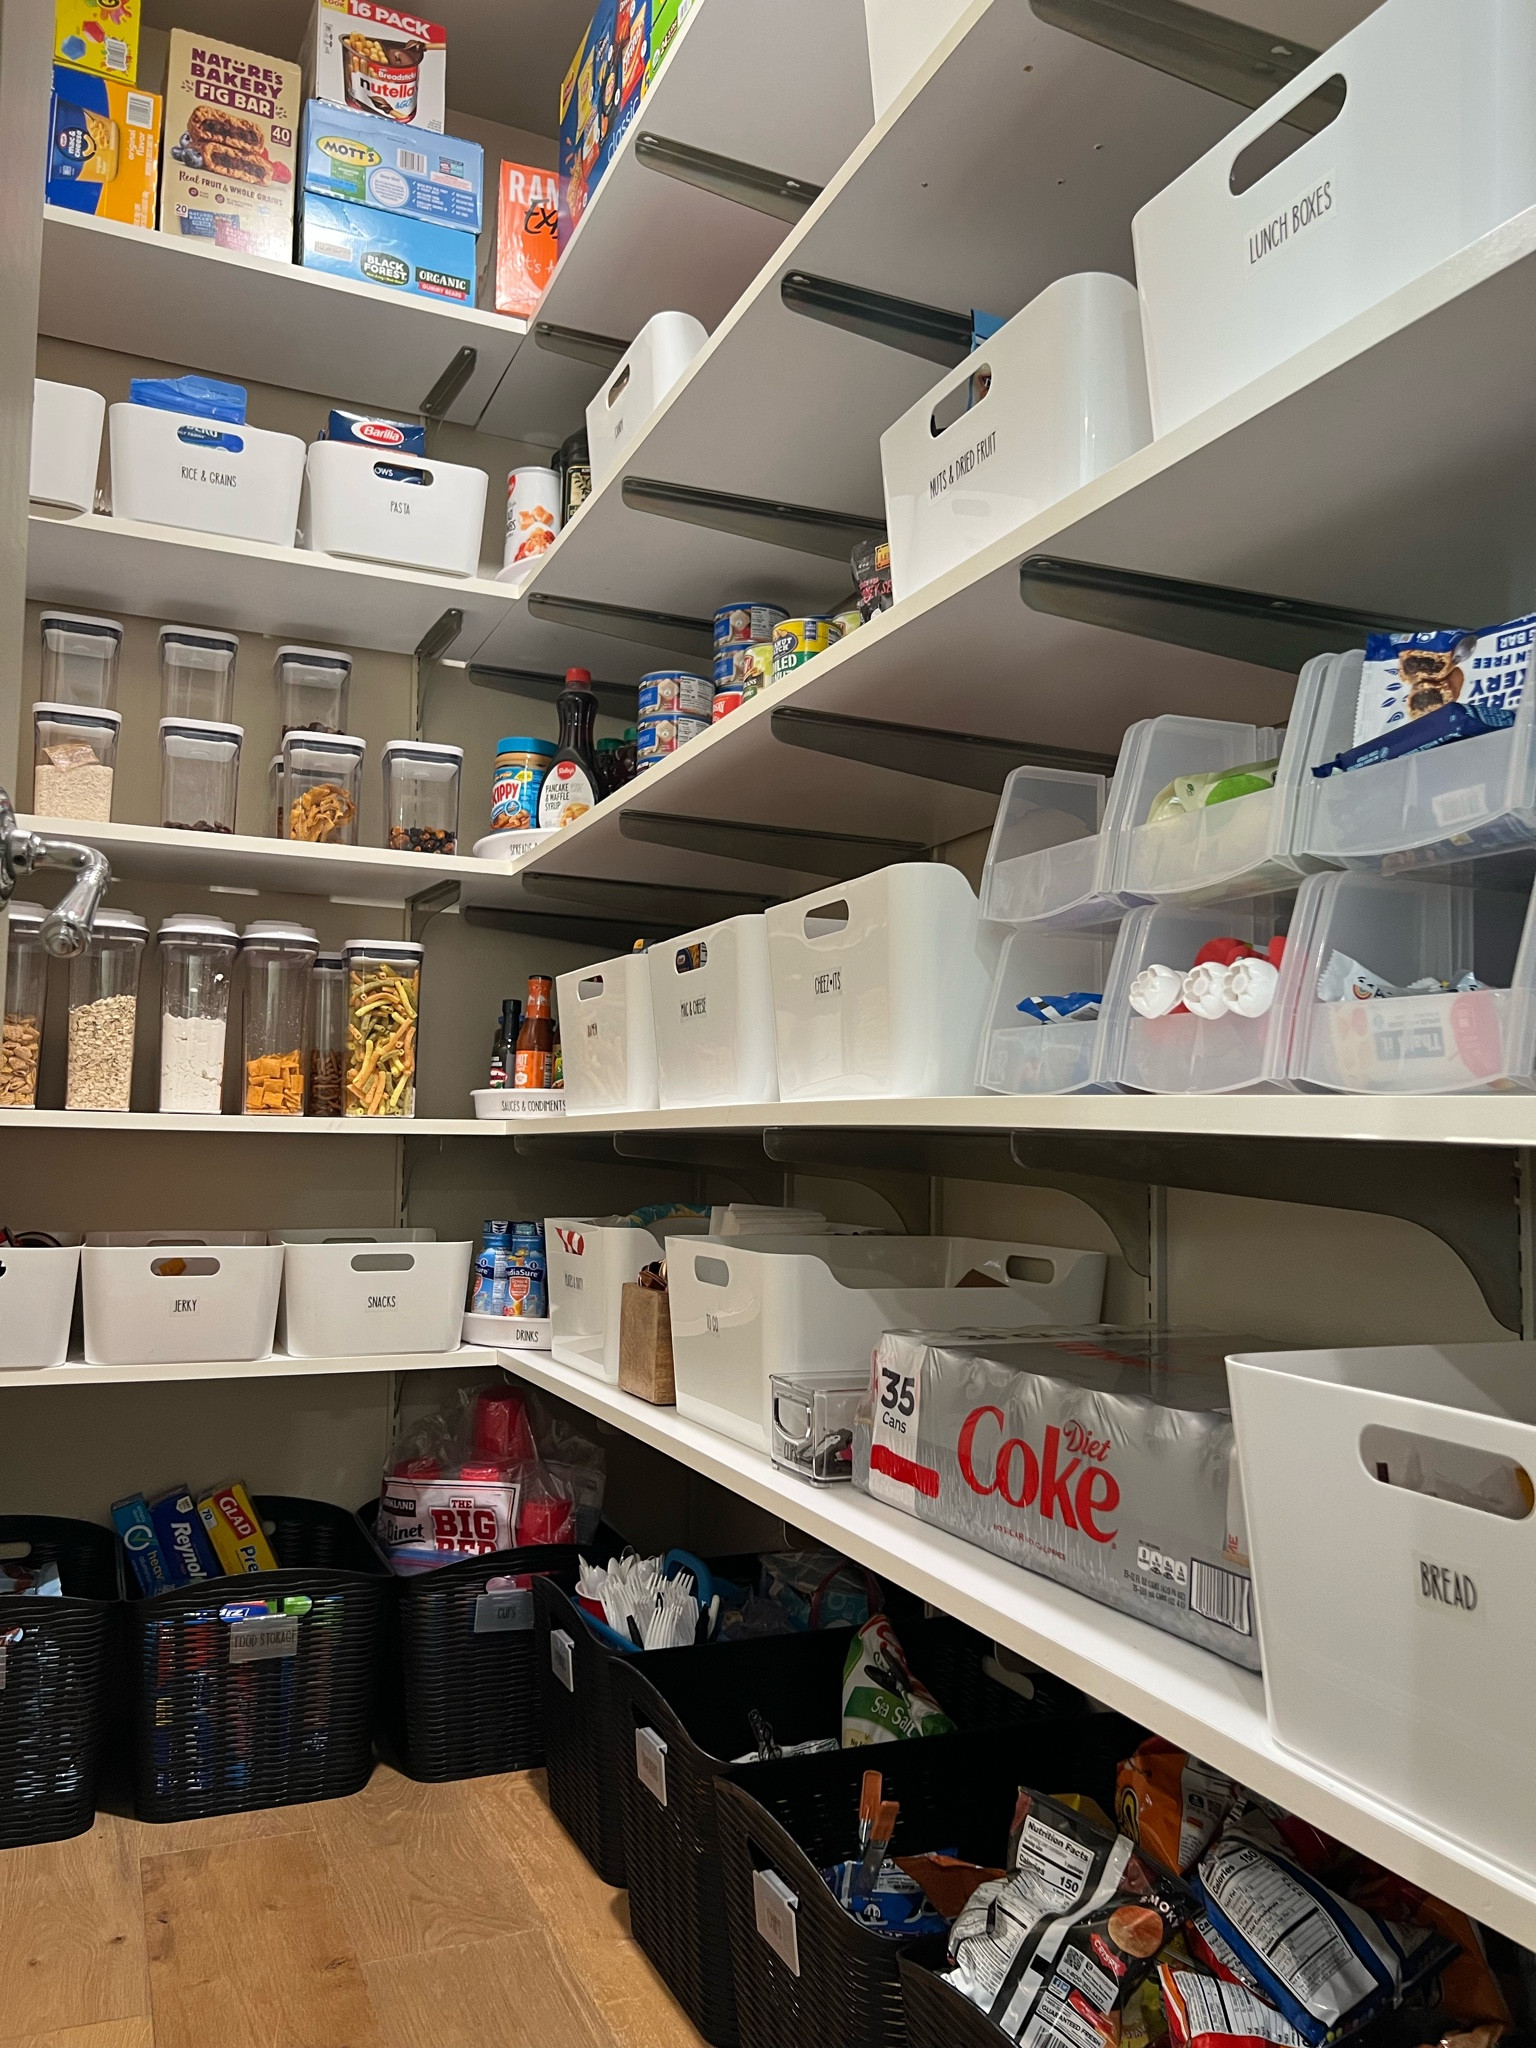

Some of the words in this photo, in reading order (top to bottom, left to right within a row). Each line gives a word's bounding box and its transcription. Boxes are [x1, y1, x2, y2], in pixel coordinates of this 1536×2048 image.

[350, 0, 371, 17] 16
[375, 8, 431, 40] PACK
[191, 62, 283, 100] BAKERY
[360, 77, 415, 98] nutella
[200, 83, 229, 104] FIG
[234, 93, 271, 116] BAR
[272, 127, 291, 142] 40
[201, 178, 222, 191] FRUIT
[229, 185, 255, 199] WHOLE
[175, 204, 187, 214] 20
[1249, 212, 1288, 265] LUNCH
[1292, 181, 1332, 234] BOXES
[363, 262, 407, 280] FOREST
[367, 254, 404, 272] BLACK
[419, 270, 466, 290] ORGANIC
[363, 425, 400, 441] Barilla
[929, 469, 947, 500] NUTS
[948, 464, 954, 485] &
[955, 450, 975, 482] DRIED
[976, 431, 997, 465] FRUIT
[181, 466, 198, 481] RICE
[200, 469, 206, 482] &
[209, 471, 237, 487] GRAINS
[390, 500, 410, 515] PASTA
[1500, 631, 1525, 649] BAR
[1473, 654, 1512, 669] FREE
[545, 783, 569, 793] PANCAKE
[550, 792, 570, 801] WAFFLE
[544, 802, 561, 812] SYRUP
[501, 1100, 520, 1112] SAUCES
[521, 1100, 526, 1112] &
[527, 1099, 566, 1112] CONDIMENTS
[173, 1299, 197, 1313] JERKY
[367, 1295, 396, 1308] SNACKS
[516, 1329, 539, 1342] DRINKS
[881, 1367, 915, 1417] 35
[882, 1410, 907, 1434] Cans
[1063, 1419, 1111, 1462] Diet
[957, 1405, 1121, 1543] Coke
[202, 1508, 213, 1520] 70
[451, 1500, 472, 1509] THE
[219, 1496, 252, 1536] GLAD
[431, 1509, 497, 1540] BIG
[1419, 1560, 1478, 1612] BREAD
[234, 1635, 257, 1649] FOOD
[871, 1696, 890, 1718] Sea
[891, 1706, 916, 1738] Salt
[1028, 1821, 1064, 1848] Nutrition
[1065, 1843, 1089, 1862] Facts
[1212, 1864, 1235, 1895] Calories
[1239, 1850, 1258, 1863] 150
[1060, 1876, 1079, 1893] 150
[1140, 1894, 1179, 1928] SMOKY
[1041, 2004, 1081, 2031] GUARANTEED
[1081, 2027, 1101, 2047] FRESH
